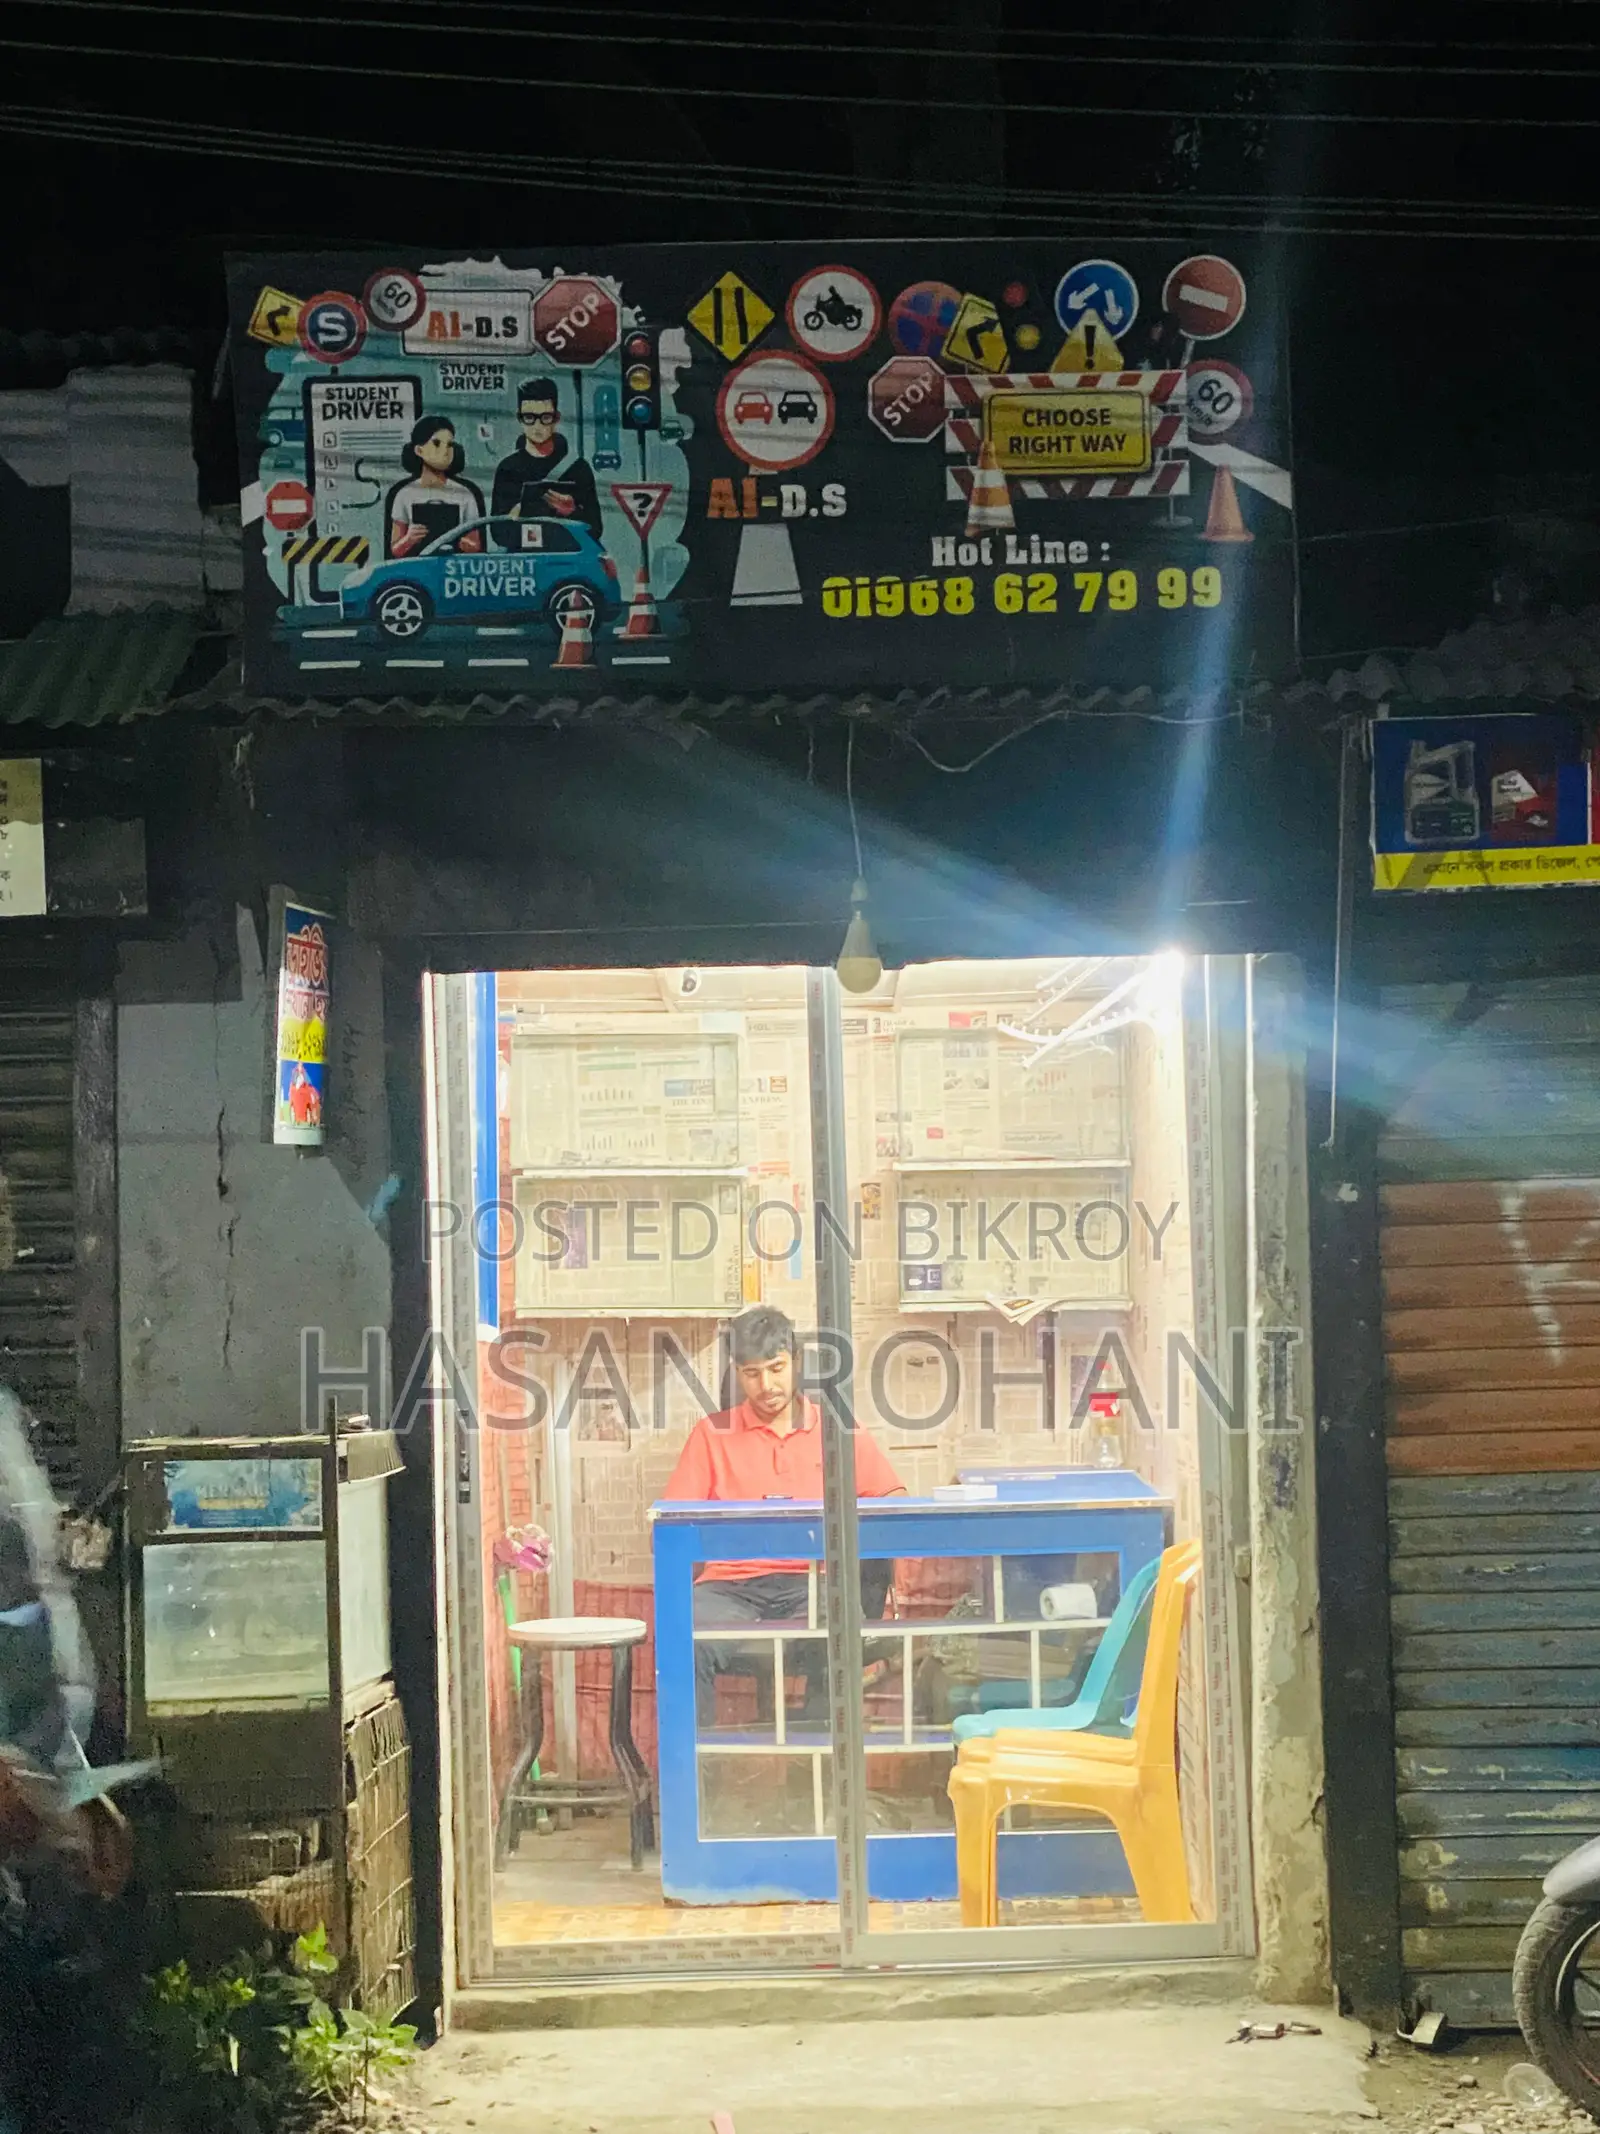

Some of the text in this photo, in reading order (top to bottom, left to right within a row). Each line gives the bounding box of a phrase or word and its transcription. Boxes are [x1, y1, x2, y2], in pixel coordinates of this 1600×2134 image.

[318, 311, 348, 344] S
[545, 292, 601, 351] STOP
[439, 363, 505, 376] STUDENT
[325, 386, 399, 402] STUDENT
[442, 375, 505, 391] DRIVER
[883, 370, 937, 427] STOP
[1198, 379, 1235, 415] 60
[321, 402, 404, 421] DRIVER
[1022, 407, 1112, 428] CHOOSE
[1008, 433, 1127, 456] RIGHT WAY
[706, 477, 848, 519] AI-D.S
[931, 536, 994, 568] Hot
[444, 558, 537, 576] STUDENT
[444, 575, 537, 597] DRIVER
[822, 565, 1223, 618] 01968 62 79 99
